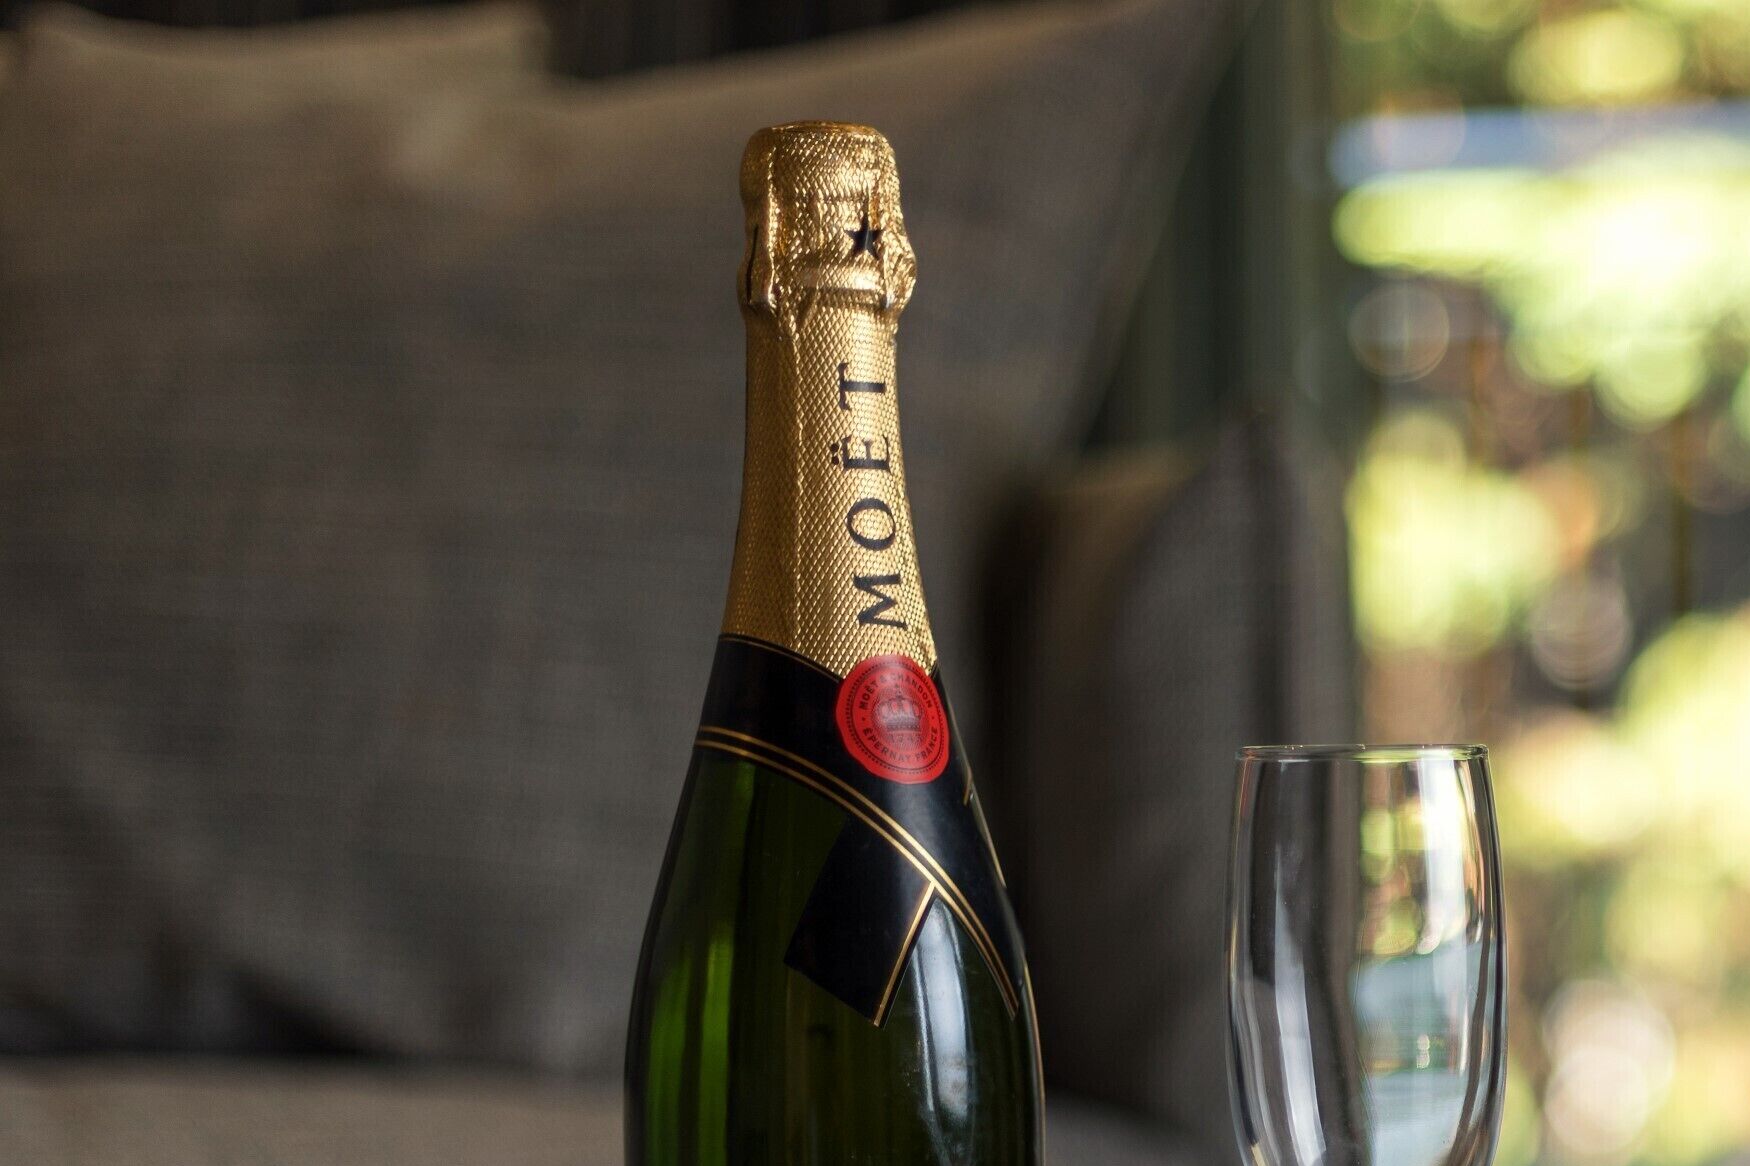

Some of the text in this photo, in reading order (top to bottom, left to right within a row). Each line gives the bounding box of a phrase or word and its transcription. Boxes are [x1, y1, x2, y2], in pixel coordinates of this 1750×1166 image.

[830, 361, 908, 631] MOËT
[890, 671, 934, 709] CHANDON
[915, 726, 938, 761] FRANCE
